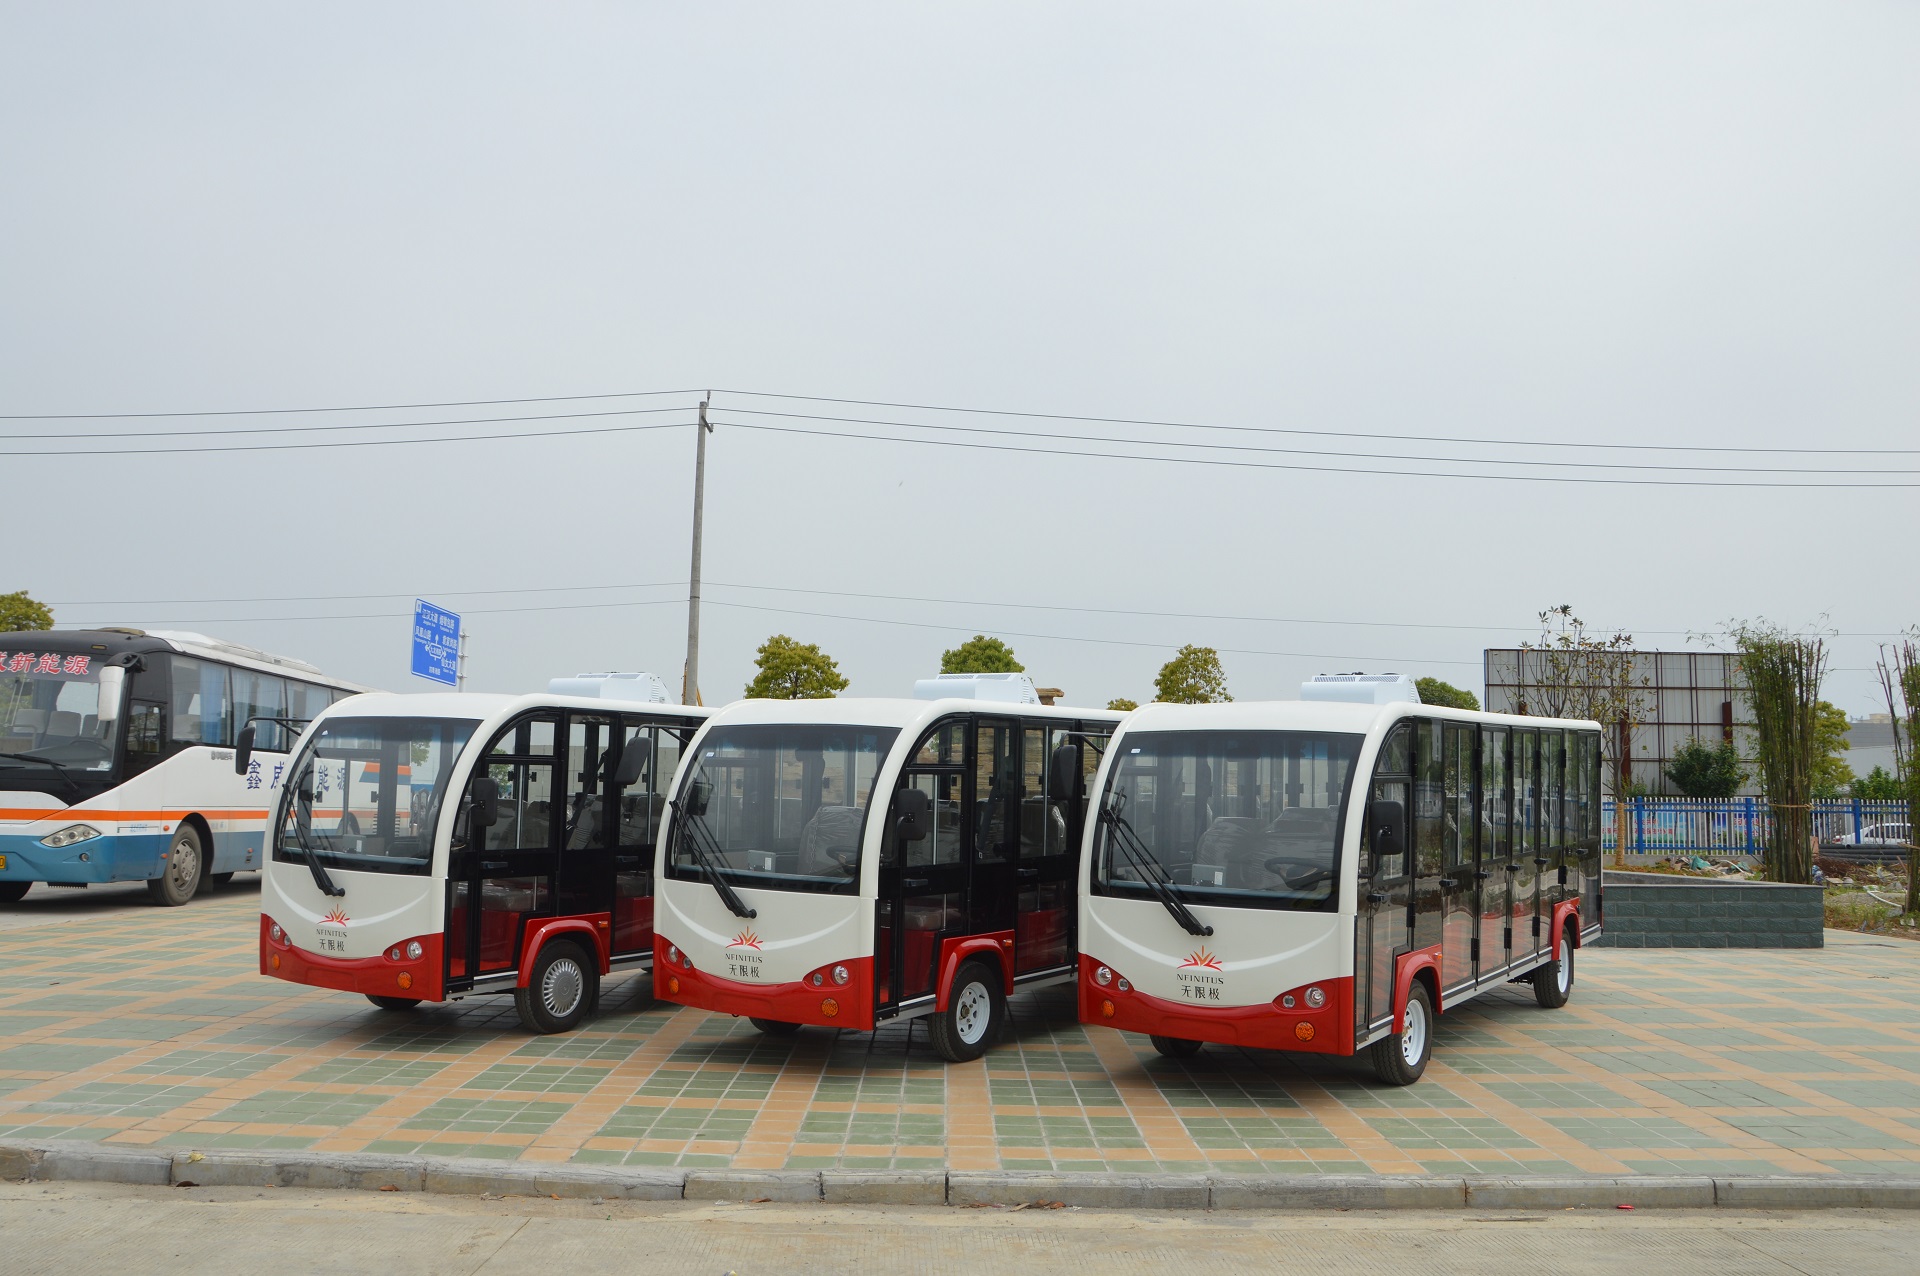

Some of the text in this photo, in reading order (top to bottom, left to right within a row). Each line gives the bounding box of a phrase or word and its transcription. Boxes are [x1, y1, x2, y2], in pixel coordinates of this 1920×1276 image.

[319, 938, 345, 952] 无限极
[725, 953, 763, 963] NFINITUS
[729, 963, 760, 978] 无限极
[1177, 973, 1224, 984] NFINITUS
[1181, 985, 1220, 1000] 无限极
